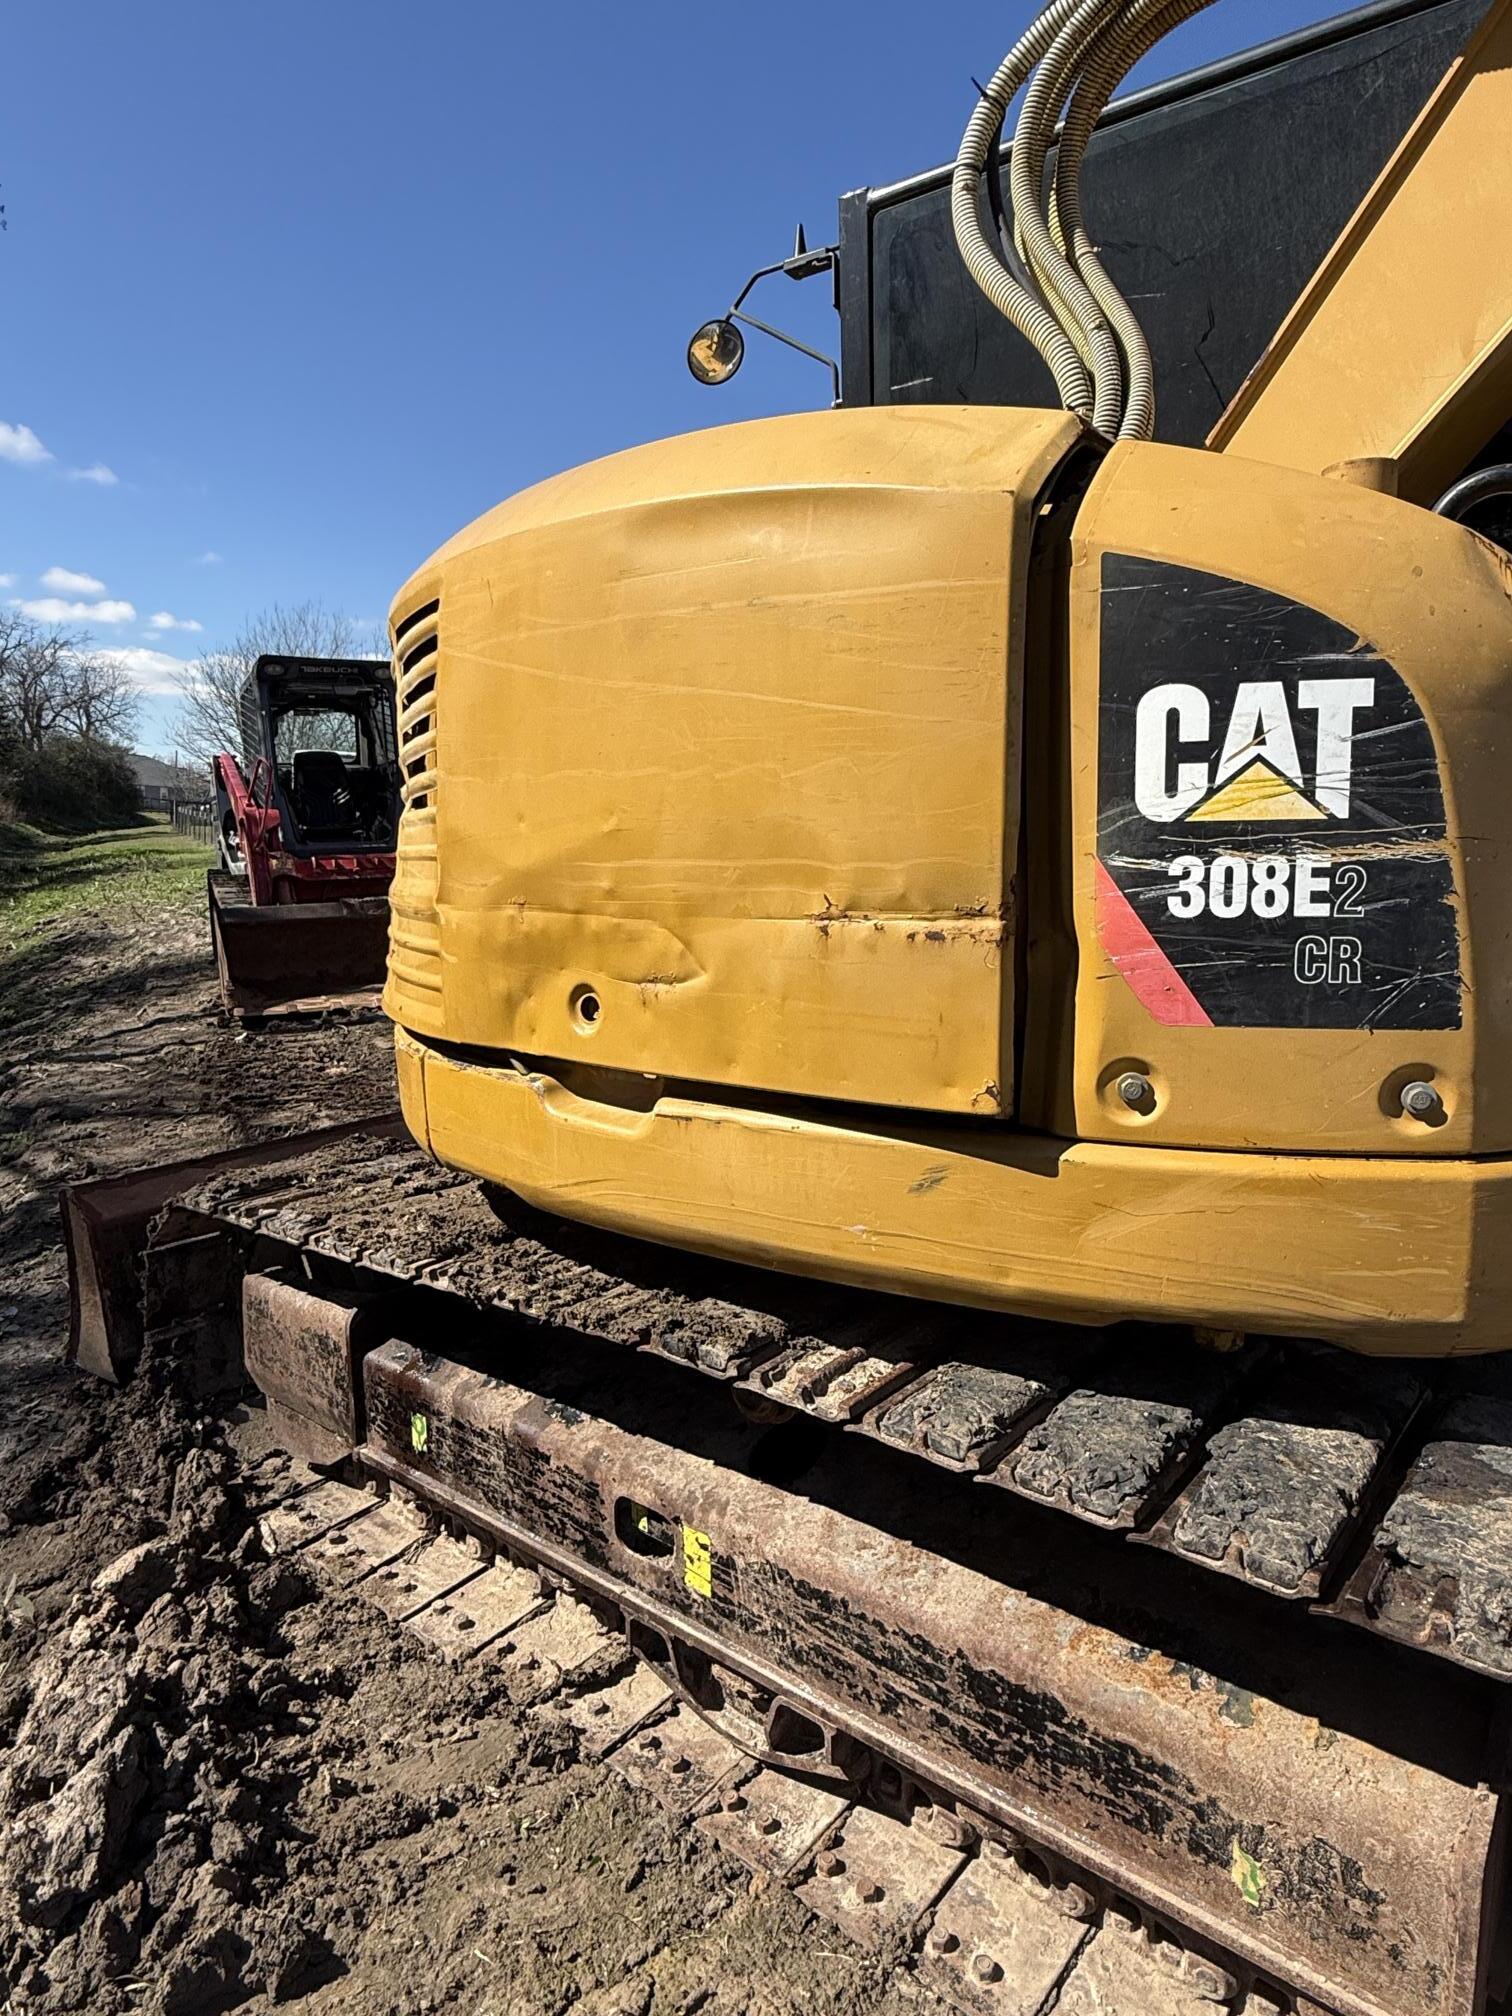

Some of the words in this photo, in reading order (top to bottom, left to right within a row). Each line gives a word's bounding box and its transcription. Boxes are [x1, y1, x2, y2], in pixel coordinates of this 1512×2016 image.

[1135, 678, 1375, 823] CAT
[1166, 855, 1367, 919] 308E2
[1294, 935, 1362, 984] CR
